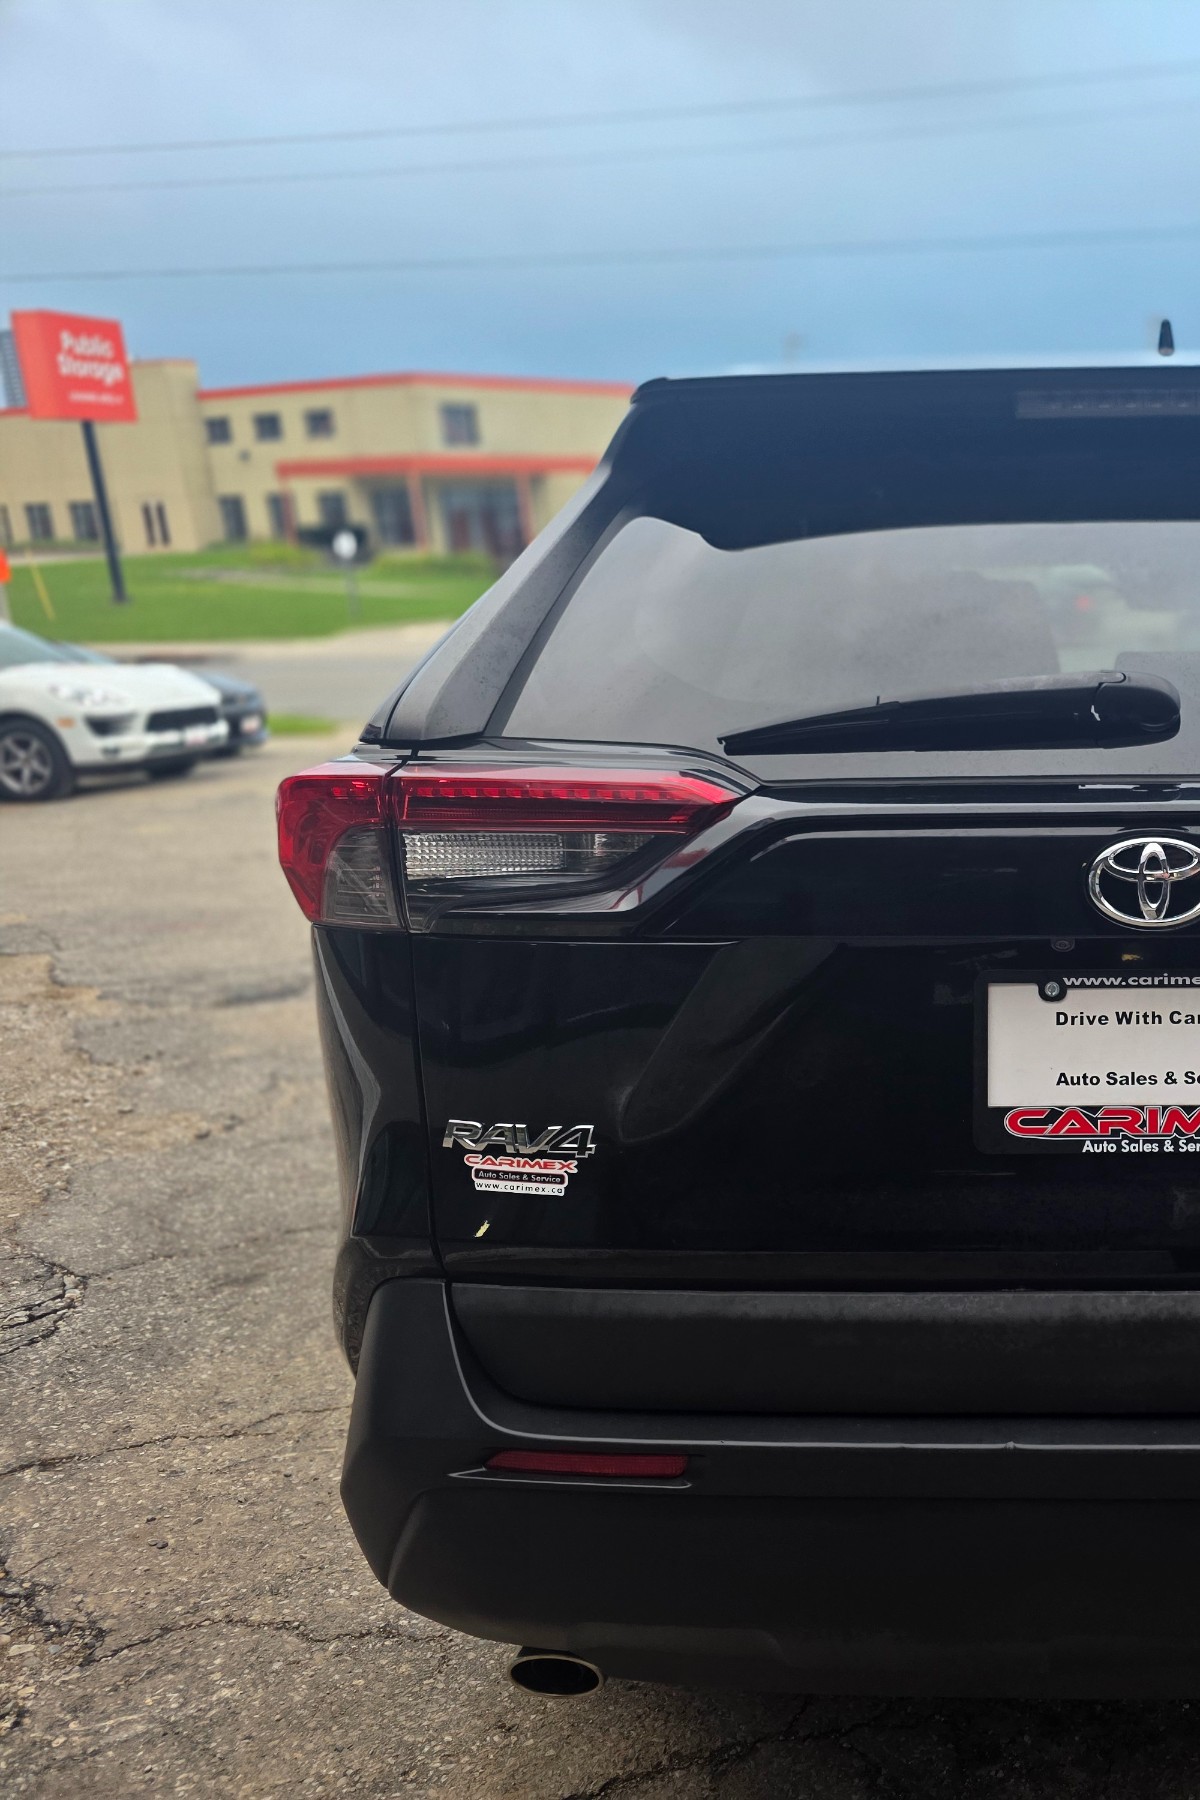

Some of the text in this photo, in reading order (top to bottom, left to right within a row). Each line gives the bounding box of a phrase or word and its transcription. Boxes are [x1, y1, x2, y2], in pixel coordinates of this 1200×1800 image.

[1055, 1010, 1109, 1026] Drive
[1115, 1010, 1163, 1026] With
[1056, 1071, 1101, 1087] Auto
[1106, 1071, 1158, 1087] Sales
[1164, 1071, 1178, 1086] &
[442, 1119, 597, 1158] RAV4
[1082, 1140, 1117, 1153] Auto
[1121, 1140, 1159, 1153] Sales
[1163, 1140, 1175, 1153] &
[465, 1155, 577, 1172] CARIMEX
[478, 1170, 497, 1179] Auto
[499, 1172, 520, 1181] Sales
[531, 1174, 561, 1183] Service
[476, 1182, 563, 1194] www.carimex.ca
